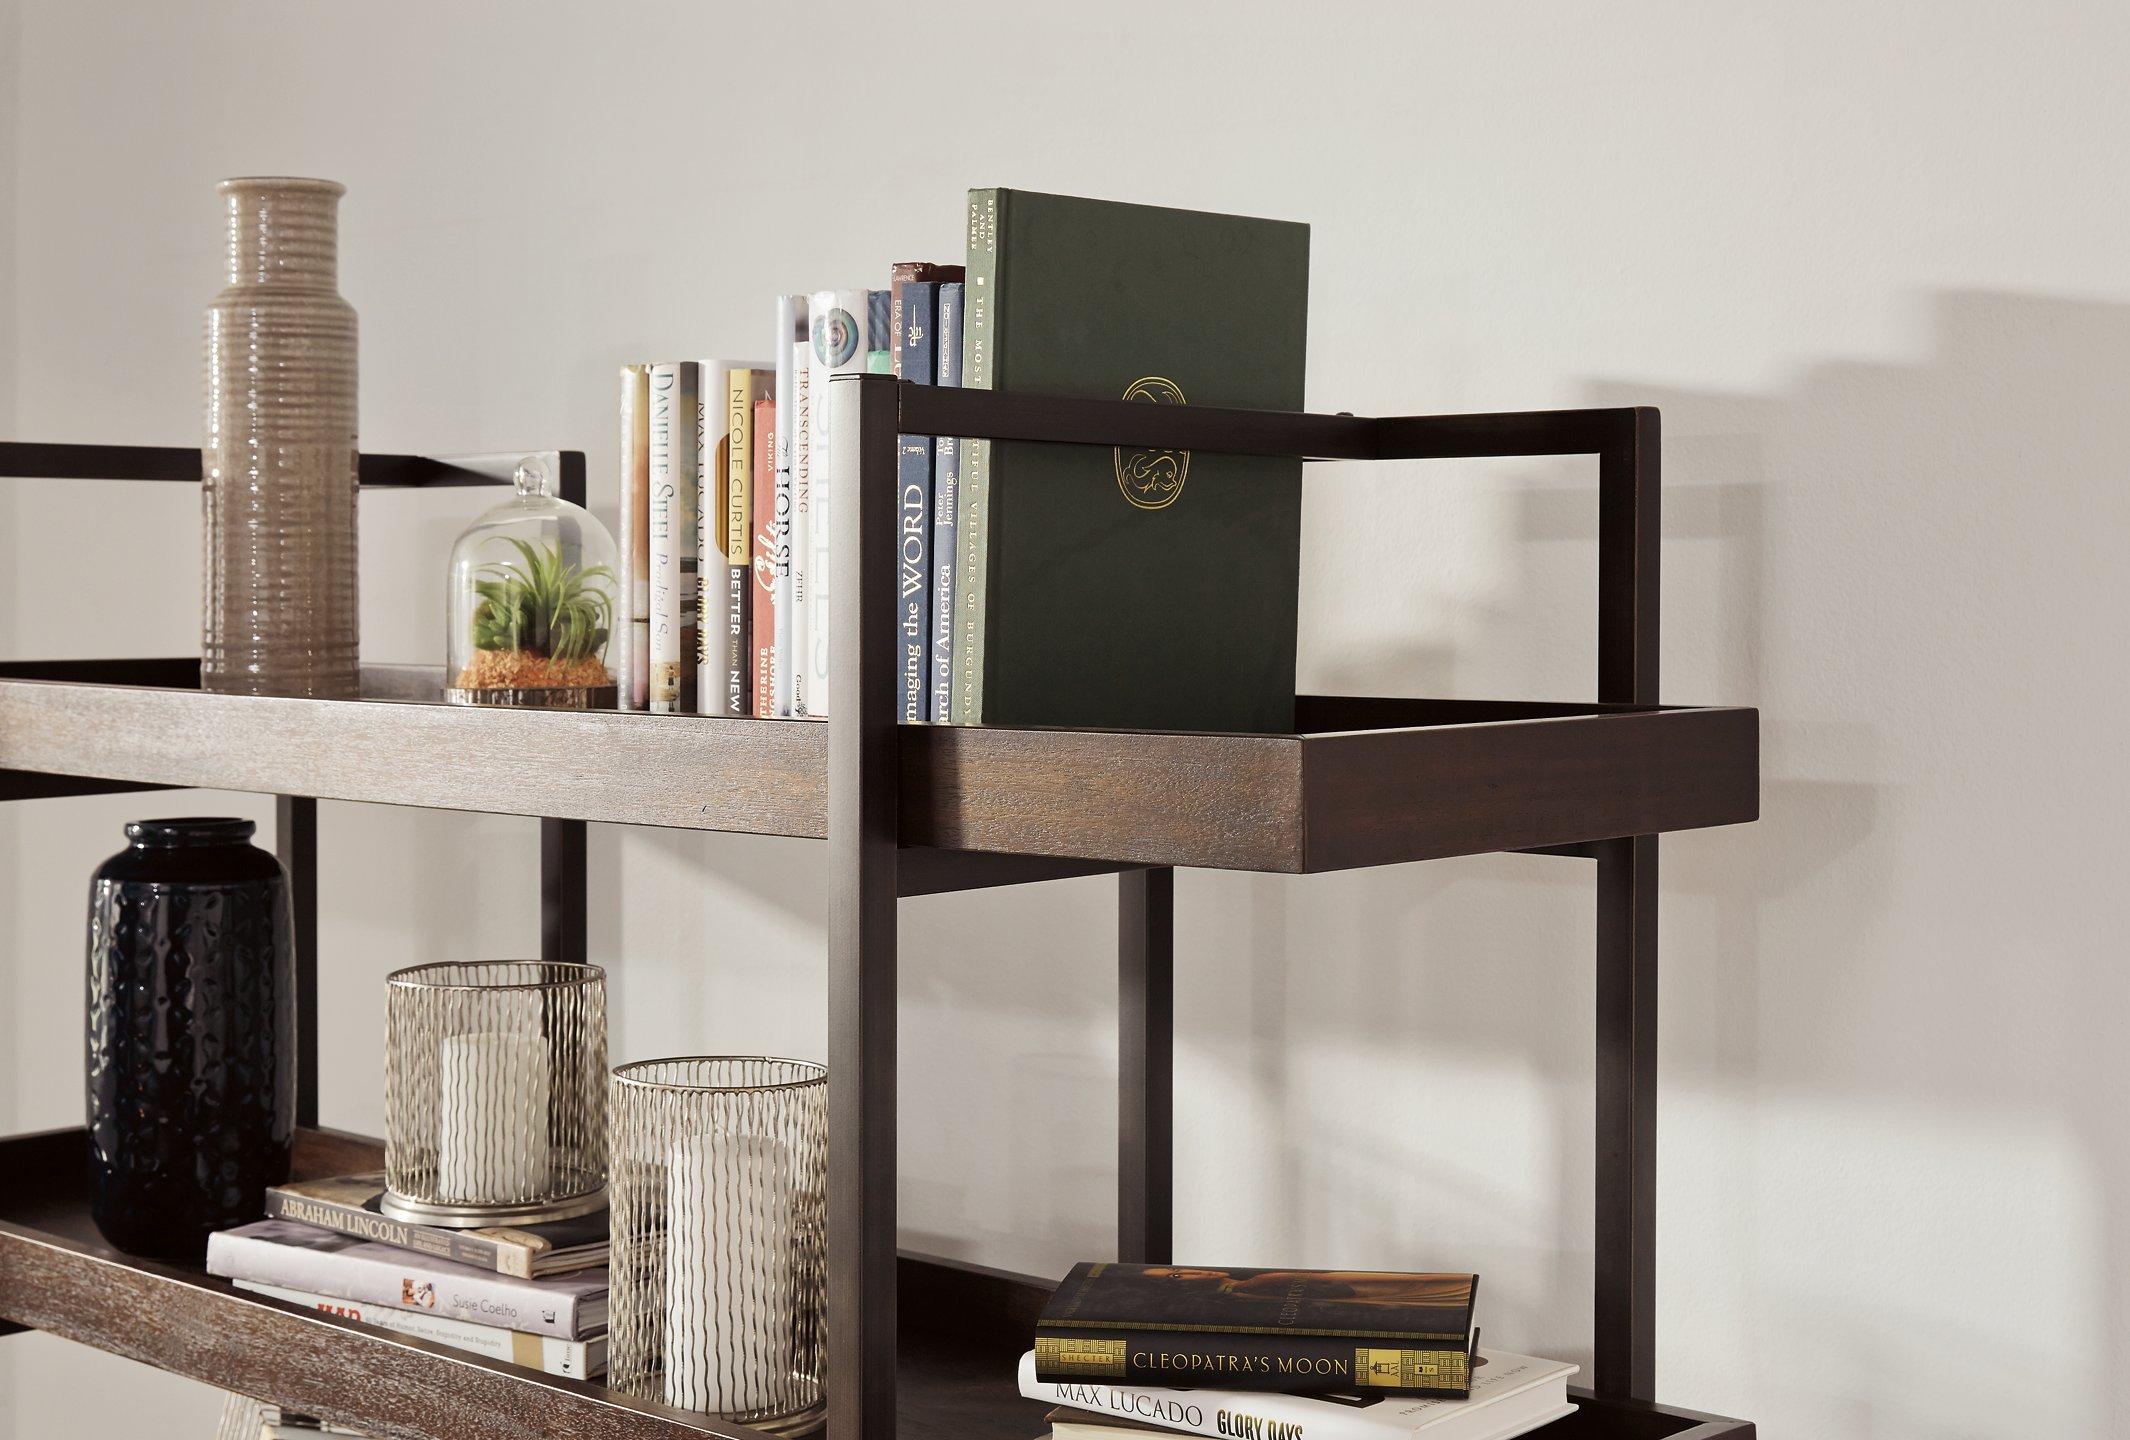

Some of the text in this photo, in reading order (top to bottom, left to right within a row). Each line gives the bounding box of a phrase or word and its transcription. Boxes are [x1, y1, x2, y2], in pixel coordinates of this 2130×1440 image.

[894, 299, 902, 319] ERA
[894, 321, 902, 337] OF
[975, 296, 984, 328] THE
[974, 339, 983, 384] MOST
[652, 371, 674, 540] DANIELLE STEEL
[798, 367, 809, 514] TRANSCENDING
[731, 388, 743, 556] NICOLE CURTIS
[936, 492, 944, 526] Peter
[943, 471, 957, 527] Jennings
[902, 484, 923, 599] WORD
[967, 502, 977, 583] VILLAGES
[902, 602, 918, 637] the
[936, 563, 951, 651] America
[967, 594, 975, 611] OF
[729, 568, 741, 712] BETTER THAN NEW
[936, 654, 949, 676] of
[963, 621, 974, 716] BURGUNDY
[280, 1199, 344, 1230] ABRAHAM
[346, 1214, 408, 1246] LINCOLN
[453, 1293, 518, 1318] Susie Coelho
[1061, 1353, 1111, 1363] SHECTER
[1133, 1352, 1349, 1376] CLEOPATRA'S MOON
[1055, 1383, 1303, 1440] MAX LUCADO GLORY DAYS
